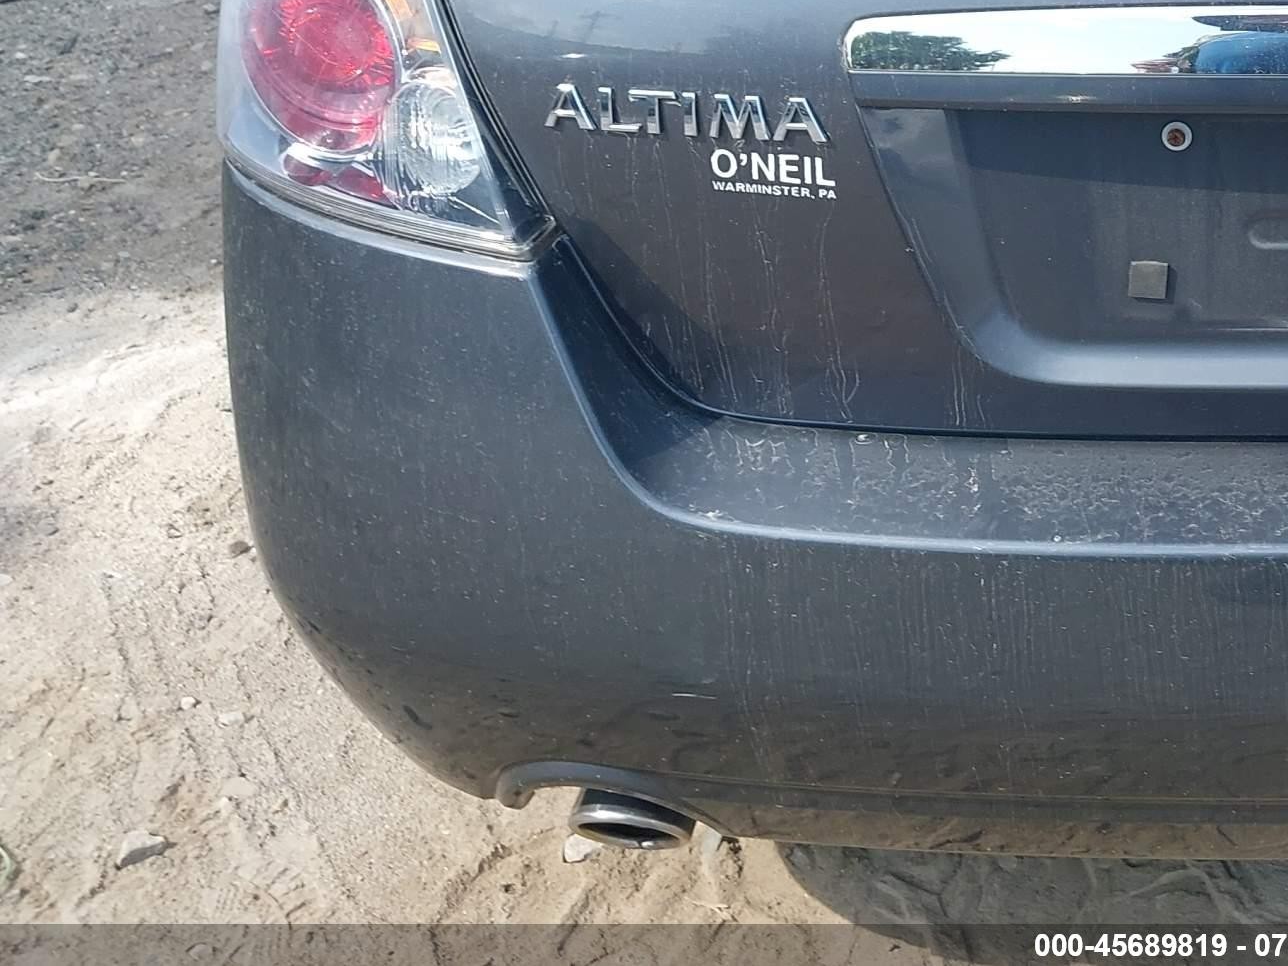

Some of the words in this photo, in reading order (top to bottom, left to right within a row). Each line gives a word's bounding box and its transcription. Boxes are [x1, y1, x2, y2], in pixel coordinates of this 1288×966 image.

[544, 83, 831, 143] ALTIMA
[710, 148, 836, 187] O'NEIL
[711, 180, 816, 200] WARMINSTER,
[818, 188, 837, 200] PA
